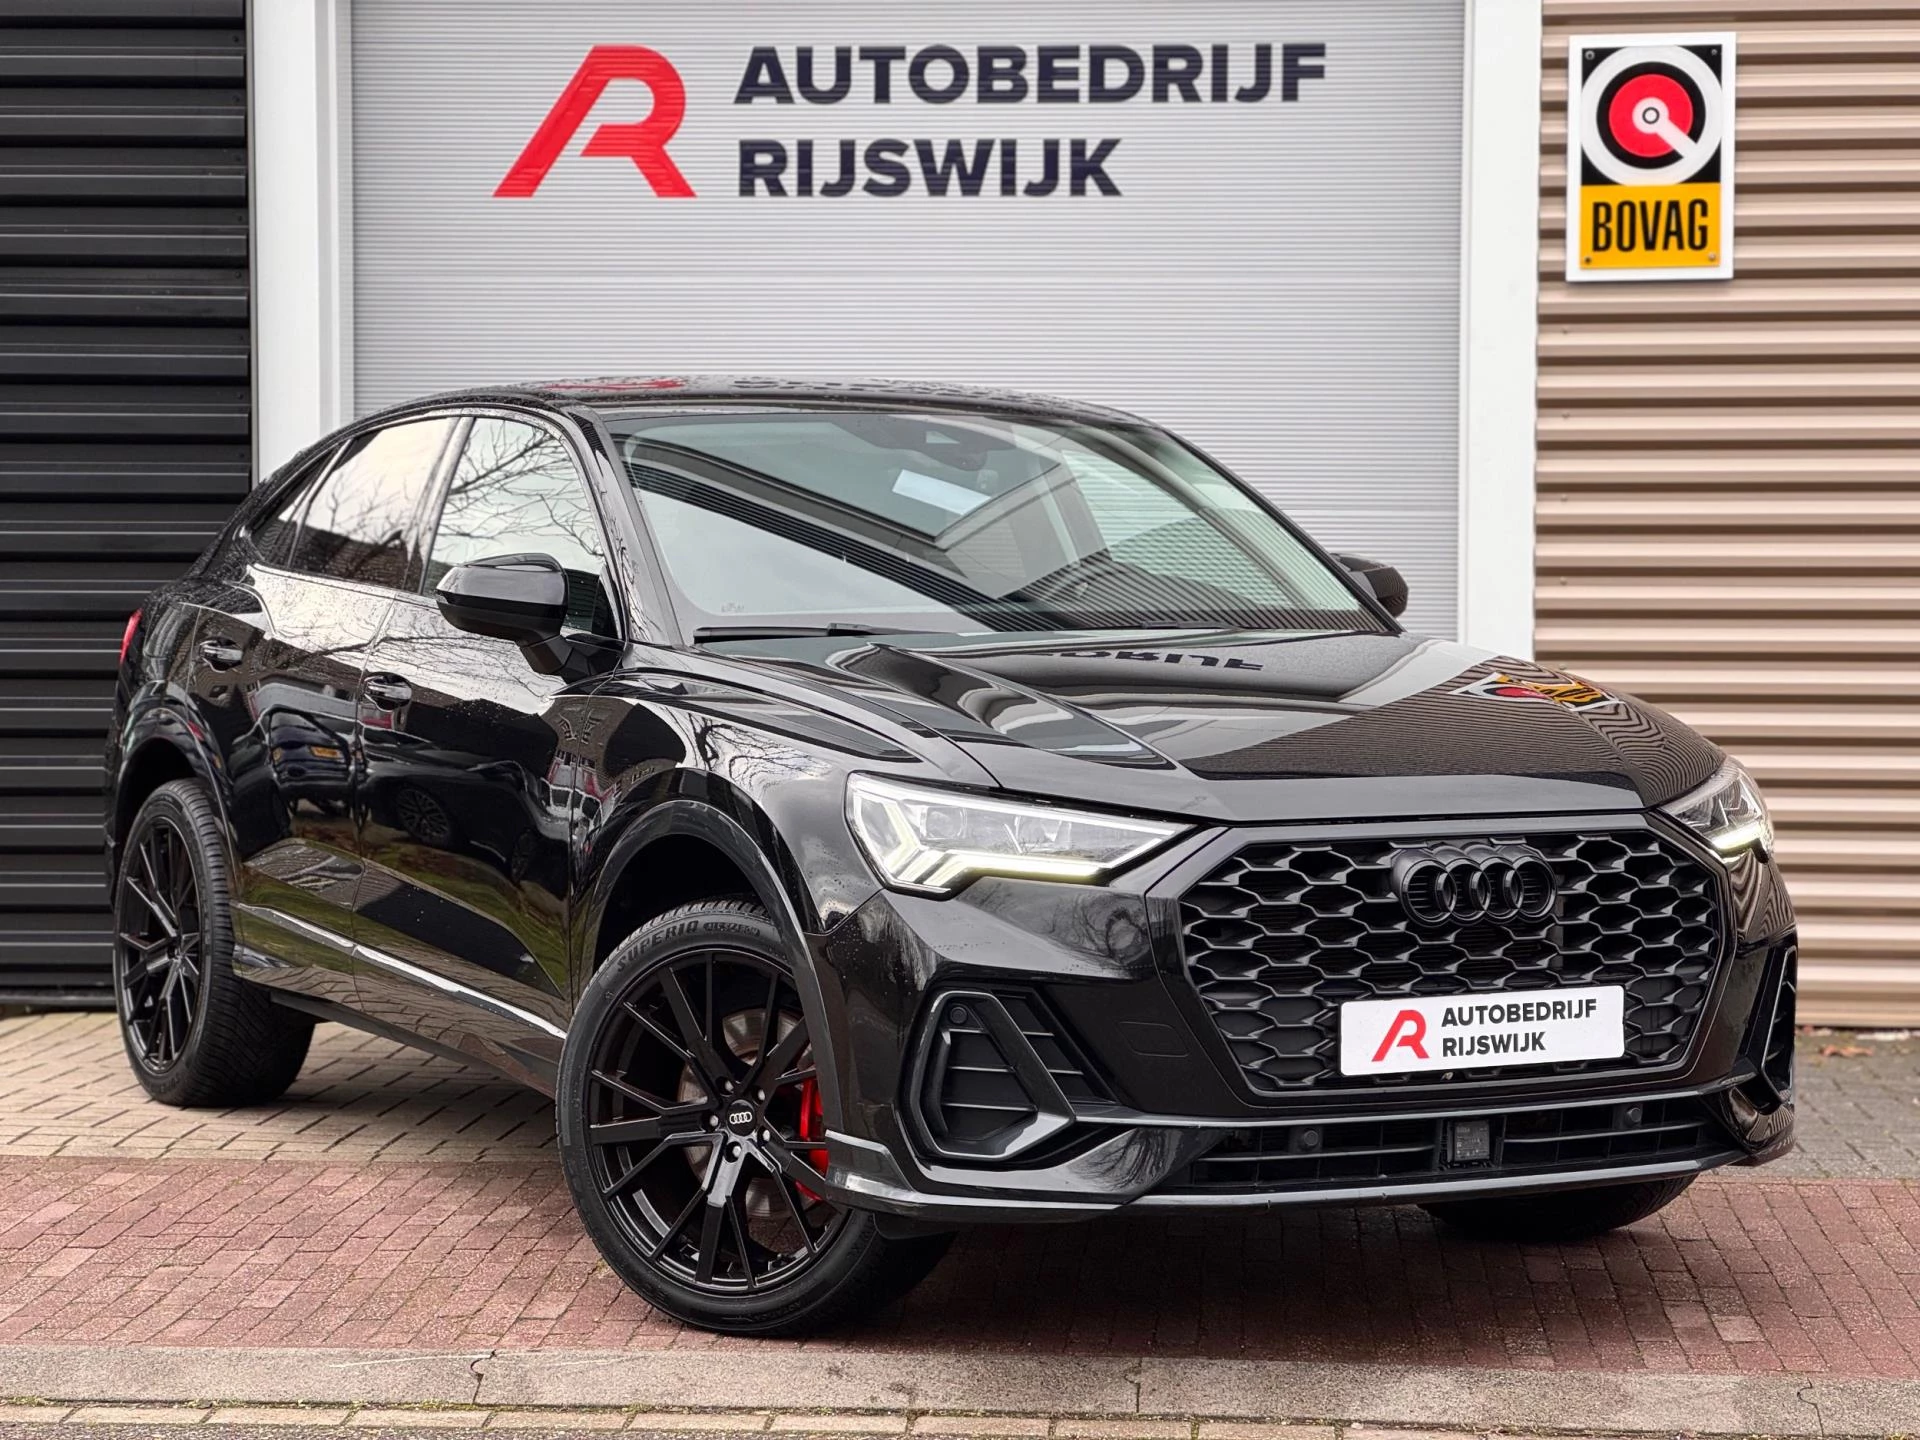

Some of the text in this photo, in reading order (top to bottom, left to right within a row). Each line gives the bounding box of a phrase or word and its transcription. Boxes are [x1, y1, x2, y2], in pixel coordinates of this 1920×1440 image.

[734, 43, 1326, 105] AUTOBEDRIJF
[739, 139, 1121, 198] RIJSWIJK
[1592, 199, 1708, 252] BOVAG
[1441, 998, 1597, 1028] AUTOBEDRIJF
[1442, 1031, 1546, 1057] RIJSWIJK
